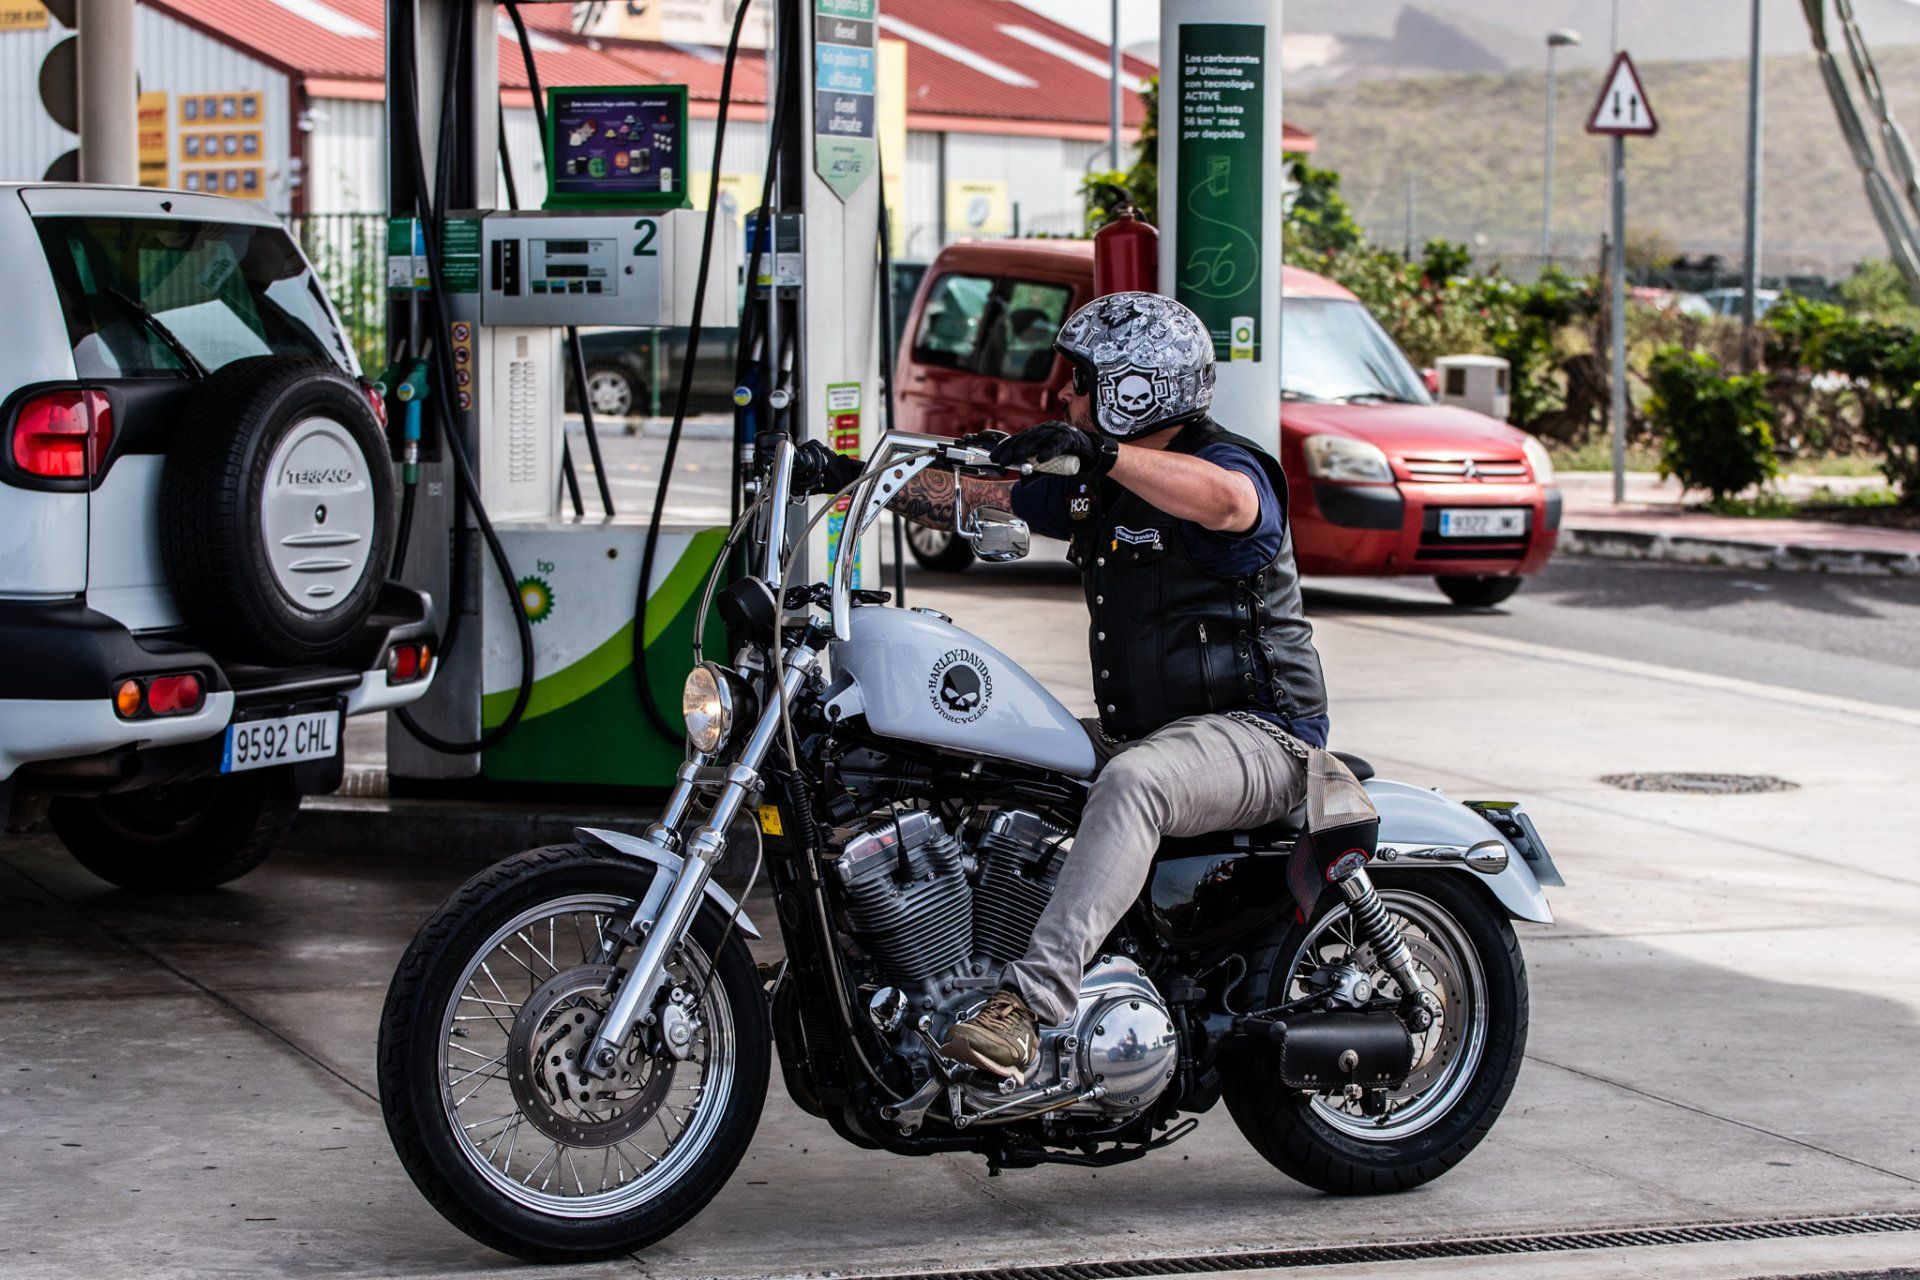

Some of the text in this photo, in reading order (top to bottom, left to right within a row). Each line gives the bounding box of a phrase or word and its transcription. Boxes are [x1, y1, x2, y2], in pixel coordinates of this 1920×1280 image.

[834, 22, 857, 40] diesel
[1184, 54, 1260, 64] Los carburantes
[1184, 66, 1244, 76] BP Ultimate
[829, 71, 862, 88] ultimate
[1184, 81, 1202, 89] con
[1184, 91, 1221, 101] ACTIVE
[834, 97, 857, 114] diesel
[1184, 104, 1245, 115] te dan hasta
[828, 116, 863, 133] ultimate
[1184, 116, 1196, 126] 56
[1218, 116, 1241, 127] más
[1183, 129, 1246, 140] por depósito
[832, 160, 862, 173] ACTIVE
[633, 219, 657, 256] 2
[1186, 242, 1236, 289] 56
[286, 469, 353, 485] TERRANO
[1070, 498, 1090, 513] HOG
[537, 558, 555, 575] bp
[928, 648, 993, 700] HARLEY-DAVIDSON
[929, 695, 989, 724] MOTORCYCLES
[237, 725, 288, 763] 9592
[295, 718, 332, 754] CHL
